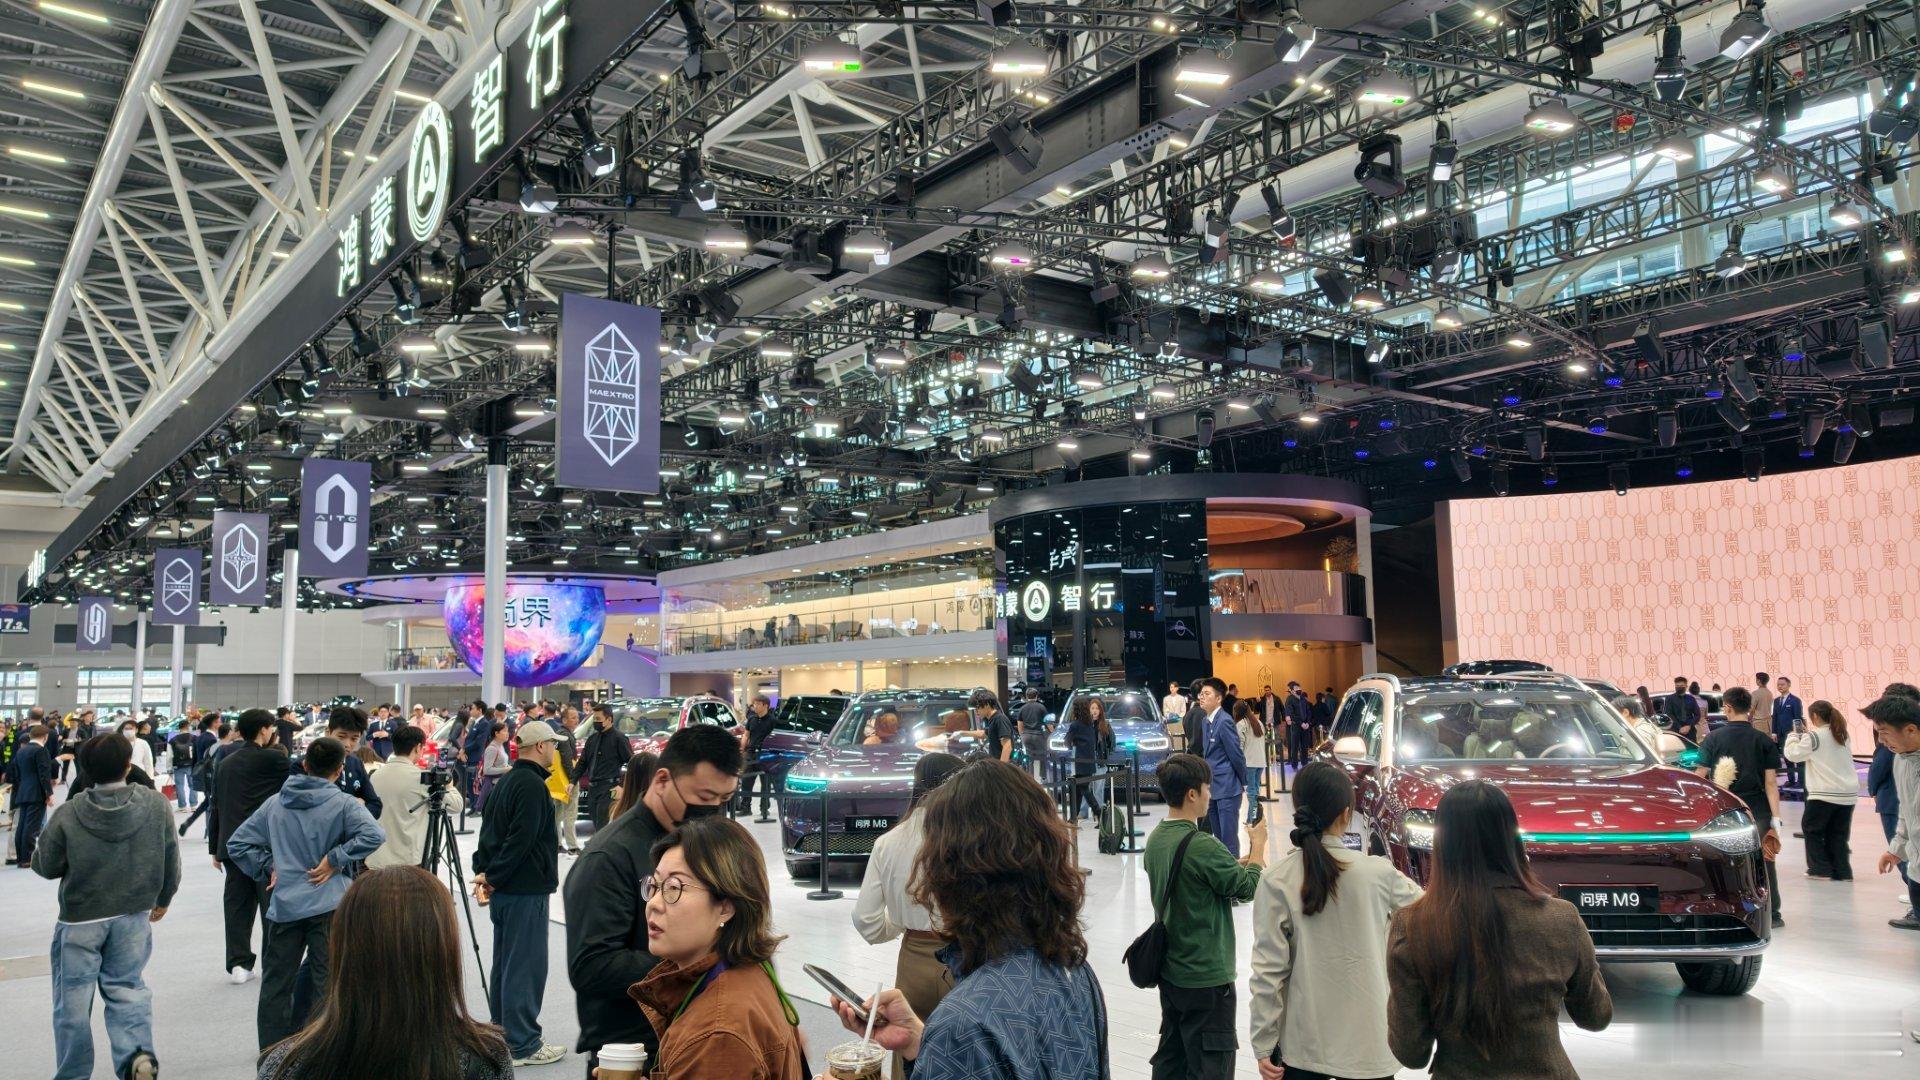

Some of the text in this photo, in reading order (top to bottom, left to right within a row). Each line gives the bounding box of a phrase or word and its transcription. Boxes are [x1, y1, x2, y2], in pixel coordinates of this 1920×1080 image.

[338, 0, 568, 297] 鸿蒙 智行
[589, 387, 635, 401] MAEXTRO
[315, 514, 357, 523] AITO
[1061, 583, 1116, 611] 智行
[855, 819, 888, 829] 问界 M8
[1580, 892, 1640, 907] 问界 M9
